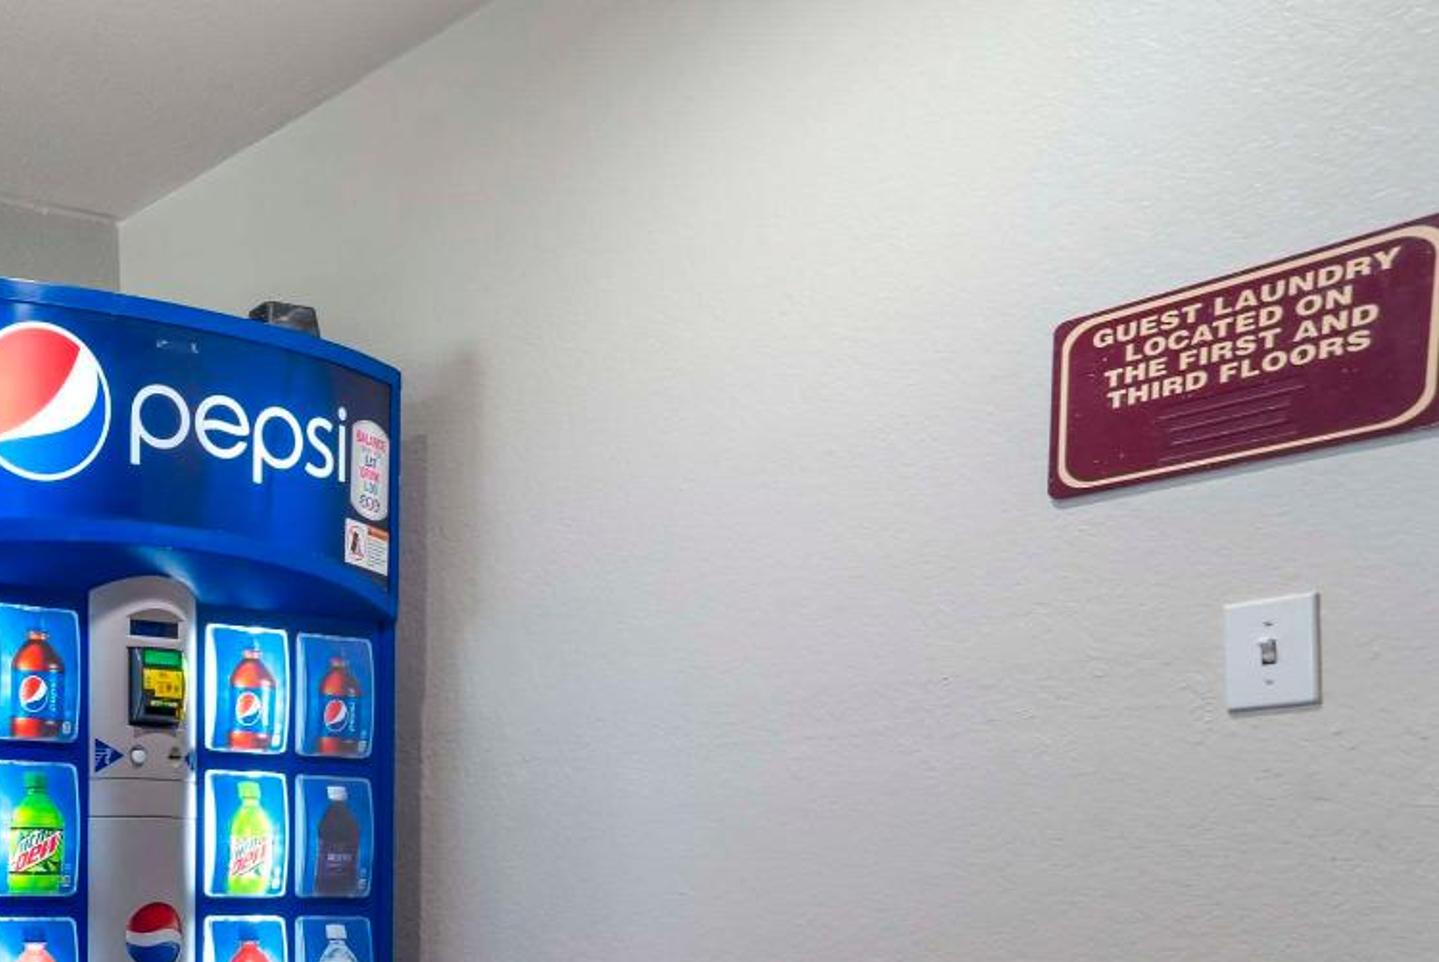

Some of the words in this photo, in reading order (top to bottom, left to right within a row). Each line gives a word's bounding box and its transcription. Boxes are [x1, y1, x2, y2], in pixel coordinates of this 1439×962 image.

[1093, 302, 1203, 349] GUEST
[1214, 246, 1403, 316] LAUNDRY
[1125, 307, 1283, 363] LOCATED
[1295, 285, 1354, 315] ON
[1104, 356, 1167, 389] THE
[1179, 328, 1284, 371] FIRST
[1293, 303, 1380, 343] AND
[1107, 370, 1208, 410] THIRD
[1219, 329, 1373, 384] FLOORS
[129, 382, 347, 485] pepsi
